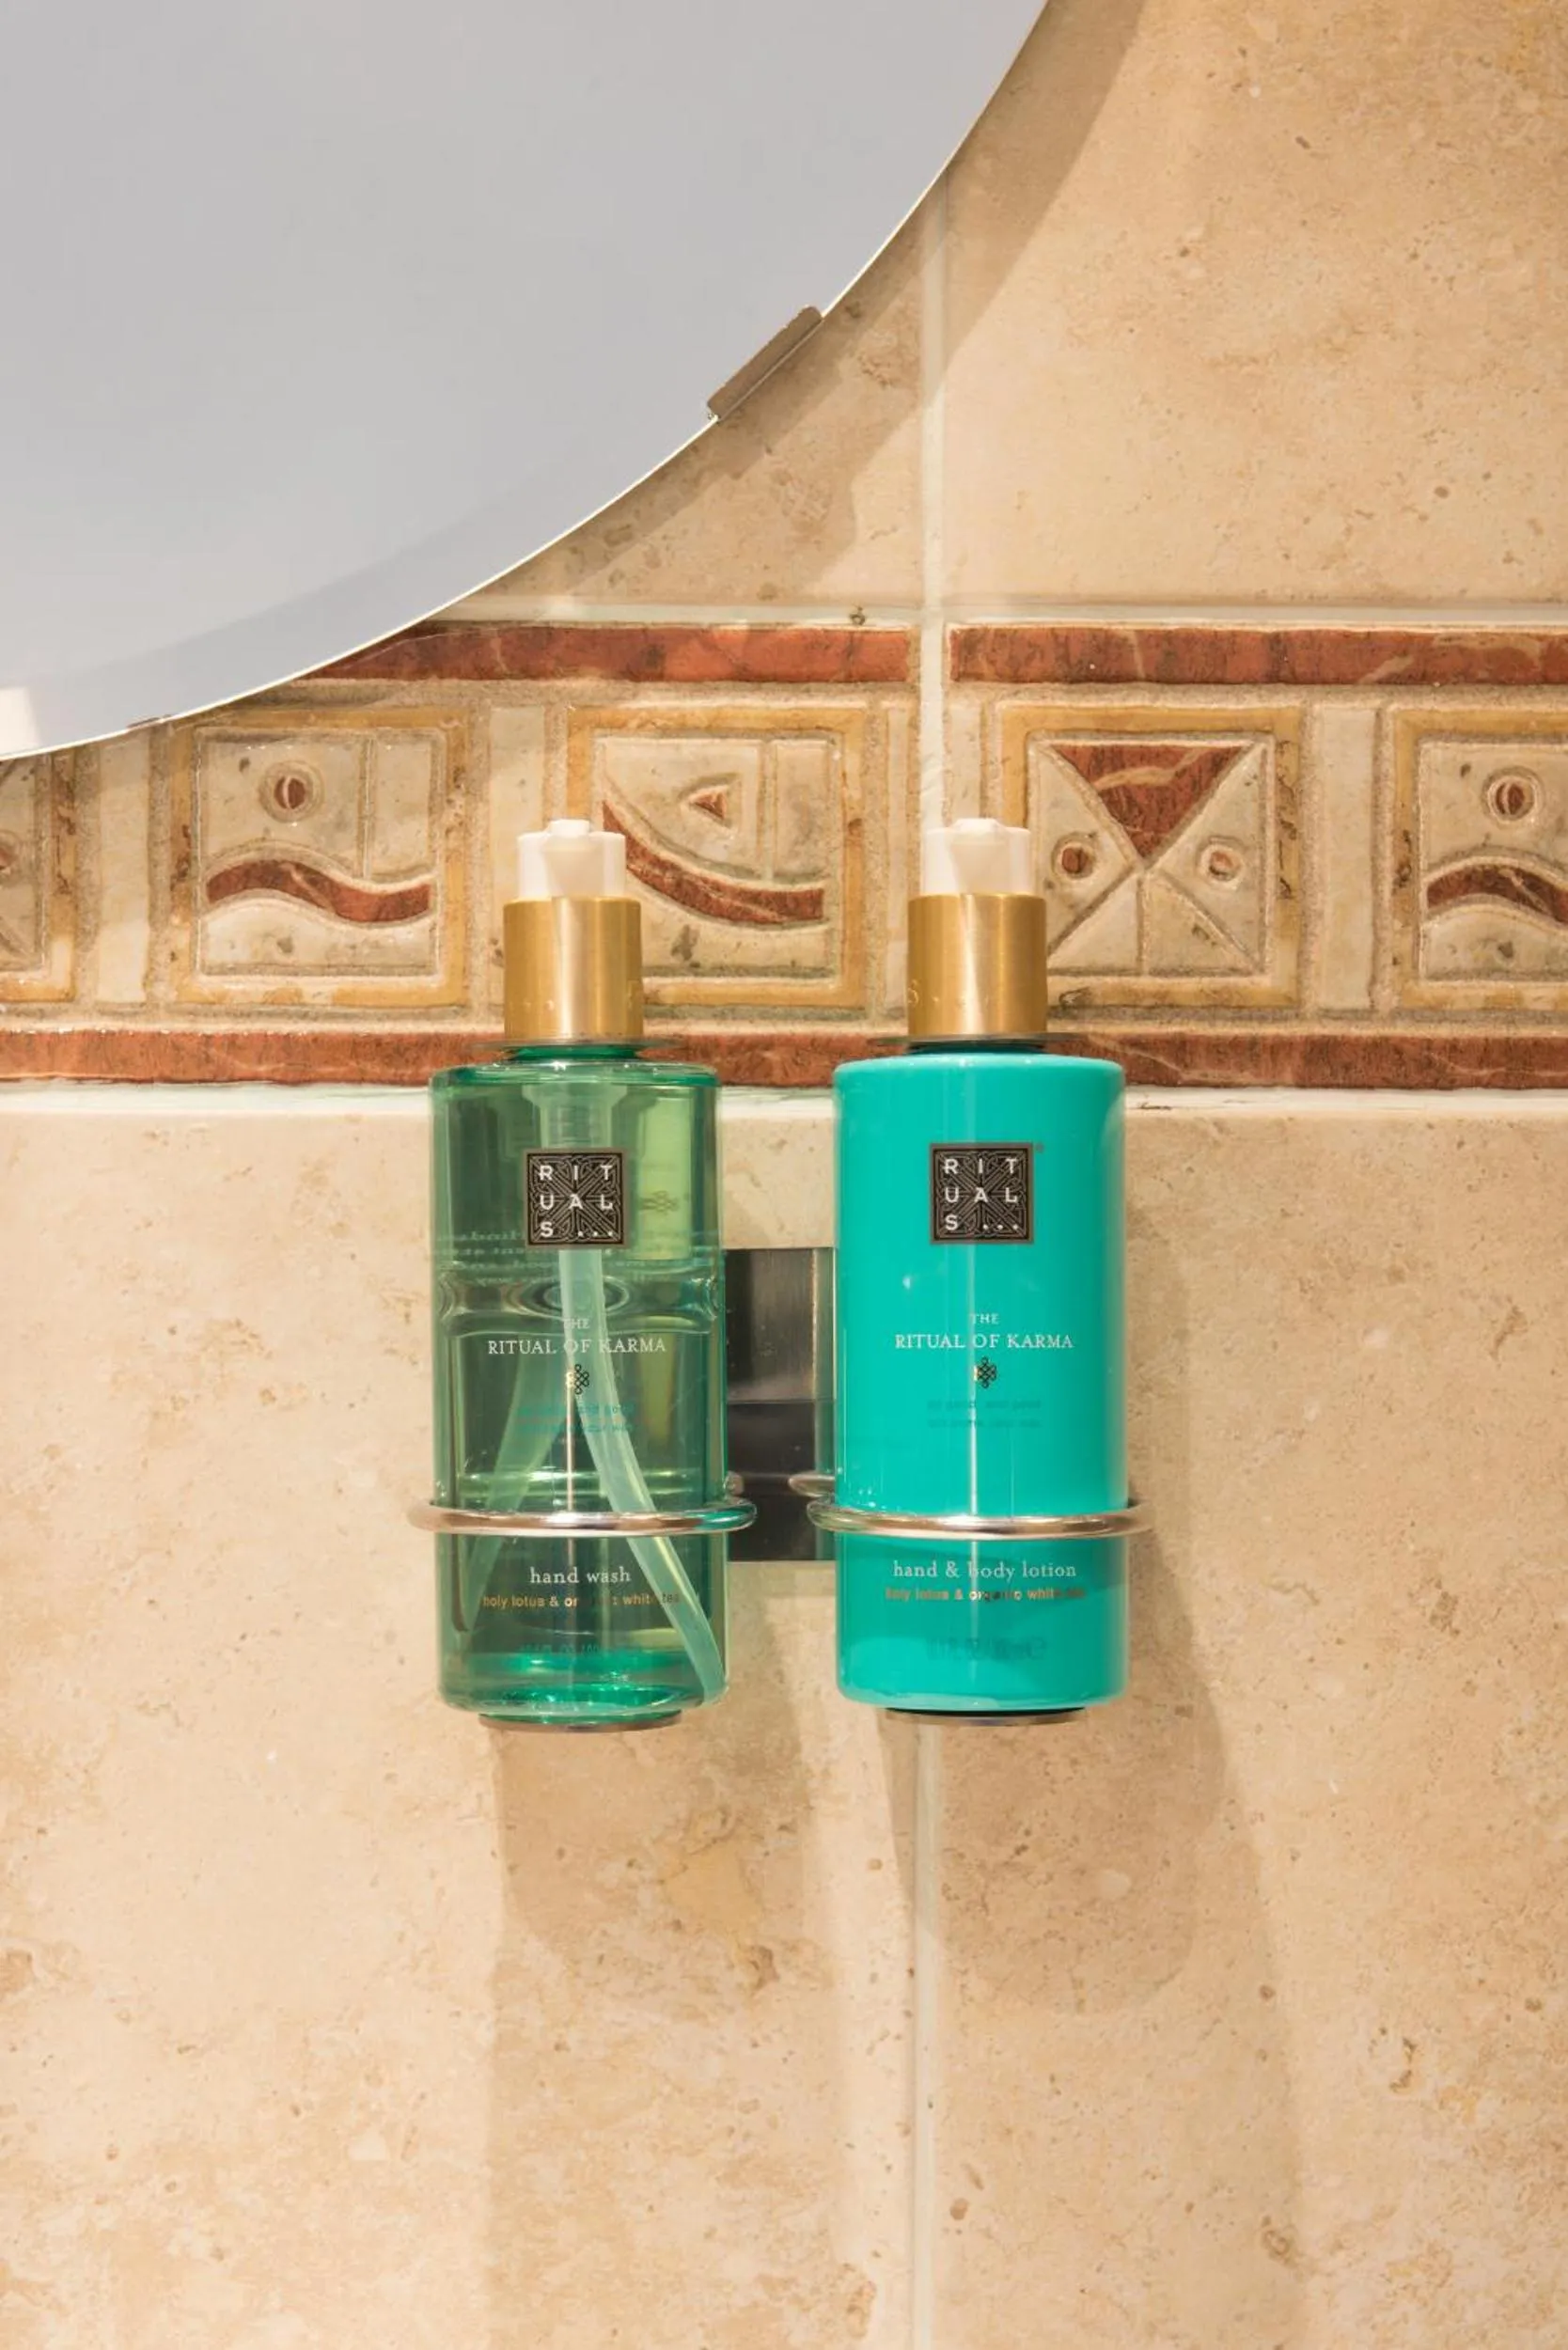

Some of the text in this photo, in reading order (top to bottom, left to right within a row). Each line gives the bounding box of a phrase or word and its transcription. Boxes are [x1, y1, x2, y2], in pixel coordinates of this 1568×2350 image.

[972, 1313, 999, 1325] THE
[488, 1338, 666, 1355] RITUAL OF KARMA
[895, 1332, 1074, 1349] RITUAL OF KARMA
[529, 1566, 632, 1584] hand wash
[893, 1560, 1076, 1583] hand & body lotion
[622, 1593, 656, 1606] whit
